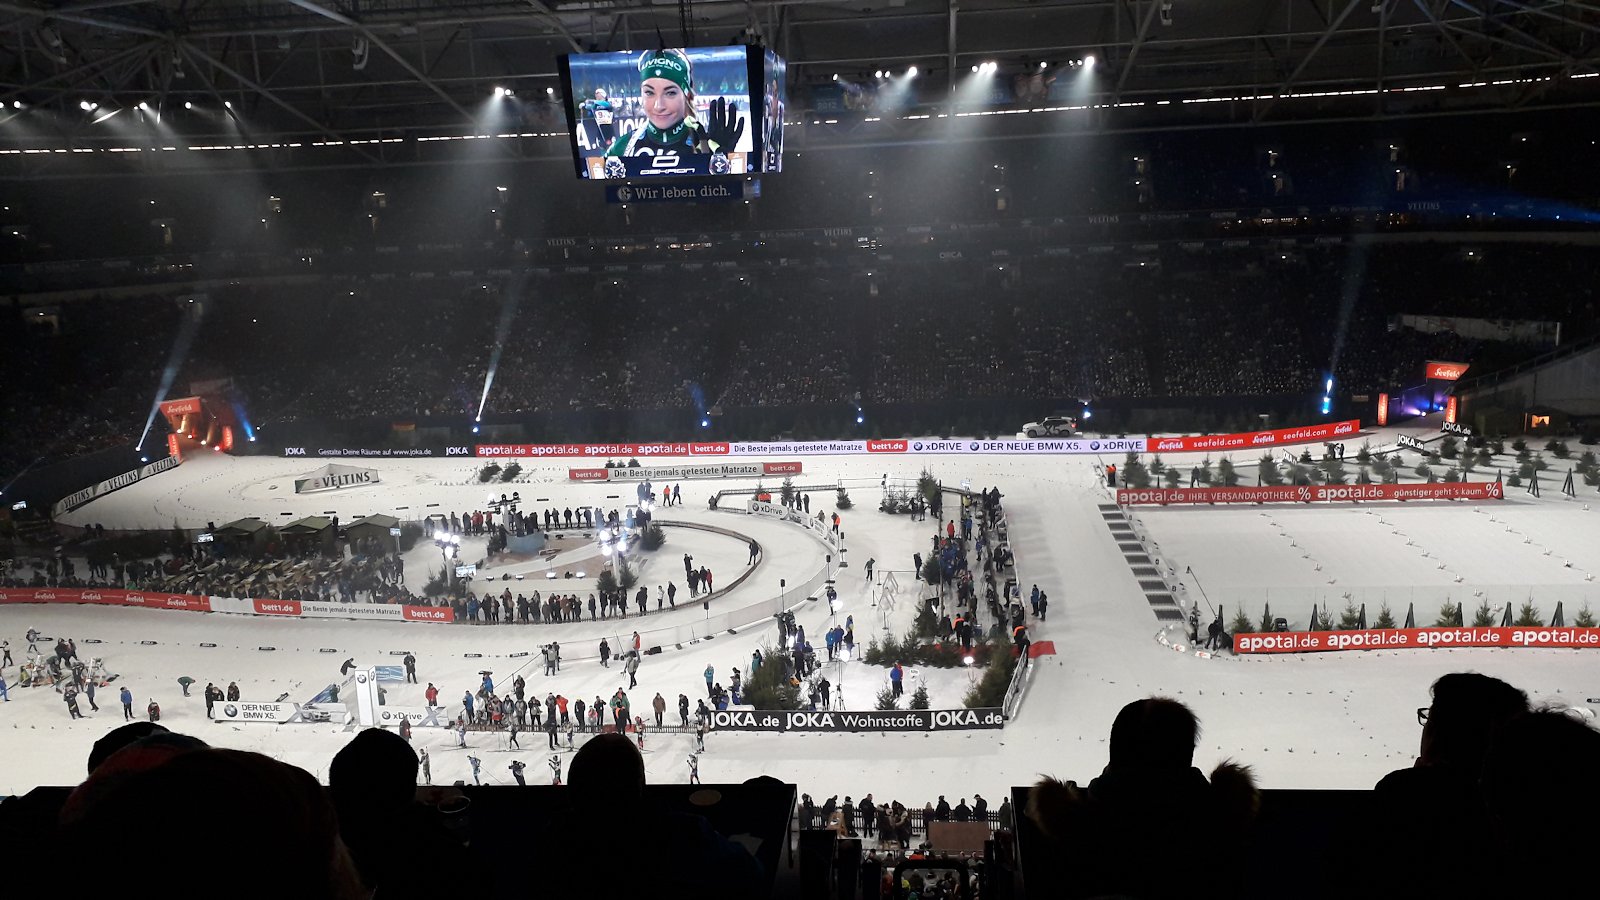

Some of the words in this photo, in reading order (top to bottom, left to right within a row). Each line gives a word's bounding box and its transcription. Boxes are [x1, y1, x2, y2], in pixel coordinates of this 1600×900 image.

[635, 187, 658, 199] Wir
[662, 186, 696, 198] leben
[700, 185, 731, 197] dich.
[1442, 421, 1471, 435] JOKA.de
[1283, 429, 1327, 440] seefeld.com
[871, 442, 903, 450] bett1.de
[926, 442, 962, 450] xDRIVE
[983, 442, 1003, 451] DER
[1006, 442, 1035, 450] NEUE
[1038, 442, 1064, 450] BMW
[1066, 442, 1082, 450] X5.
[1103, 441, 1142, 450] xDRIVE
[1193, 438, 1244, 448] seefeld.com
[1398, 434, 1424, 450] JOKA.de
[285, 447, 306, 455] JOKA
[393, 448, 432, 456] www.joka.de
[446, 447, 468, 455] JOKA
[479, 446, 525, 456] apotal.de
[531, 445, 579, 456] apotal.de
[585, 445, 632, 455] apotal.de
[638, 444, 686, 454] apotal.de
[768, 444, 791, 454] jemals
[793, 444, 827, 454] getestete
[830, 443, 863, 451] Matratze
[152, 456, 177, 473] VELTINS
[770, 464, 796, 472] bett1.de
[629, 469, 651, 477] Beste
[653, 468, 679, 479] jemals
[681, 467, 719, 477] getestete
[721, 465, 757, 474] Matratze
[108, 470, 137, 489] VELTINS
[322, 472, 370, 487] VELTINS
[1120, 491, 1184, 503] apotal.de
[1189, 492, 1207, 500] IHRE
[1211, 491, 1294, 500] VERSANDAPOTHEKE
[1298, 487, 1311, 500] %
[1317, 487, 1383, 501] apotal.de
[1461, 487, 1484, 496] kaum.
[1485, 483, 1499, 497] %
[63, 489, 90, 508] VELTINS
[760, 506, 783, 516] xDrive
[261, 603, 293, 612] bett1.de
[349, 607, 375, 615] getestete
[411, 610, 445, 619] bett1.de
[1328, 631, 1407, 648] apotal.de
[1417, 630, 1500, 646] apotal.de
[1512, 629, 1599, 646] apotal.de
[1239, 635, 1319, 651] apotal.de
[259, 704, 280, 712] NEUE
[709, 711, 779, 729] JOKA.de
[786, 712, 831, 729] JOKA
[841, 714, 923, 728] Wohnstoffe
[929, 710, 1003, 730] JOKA.de
